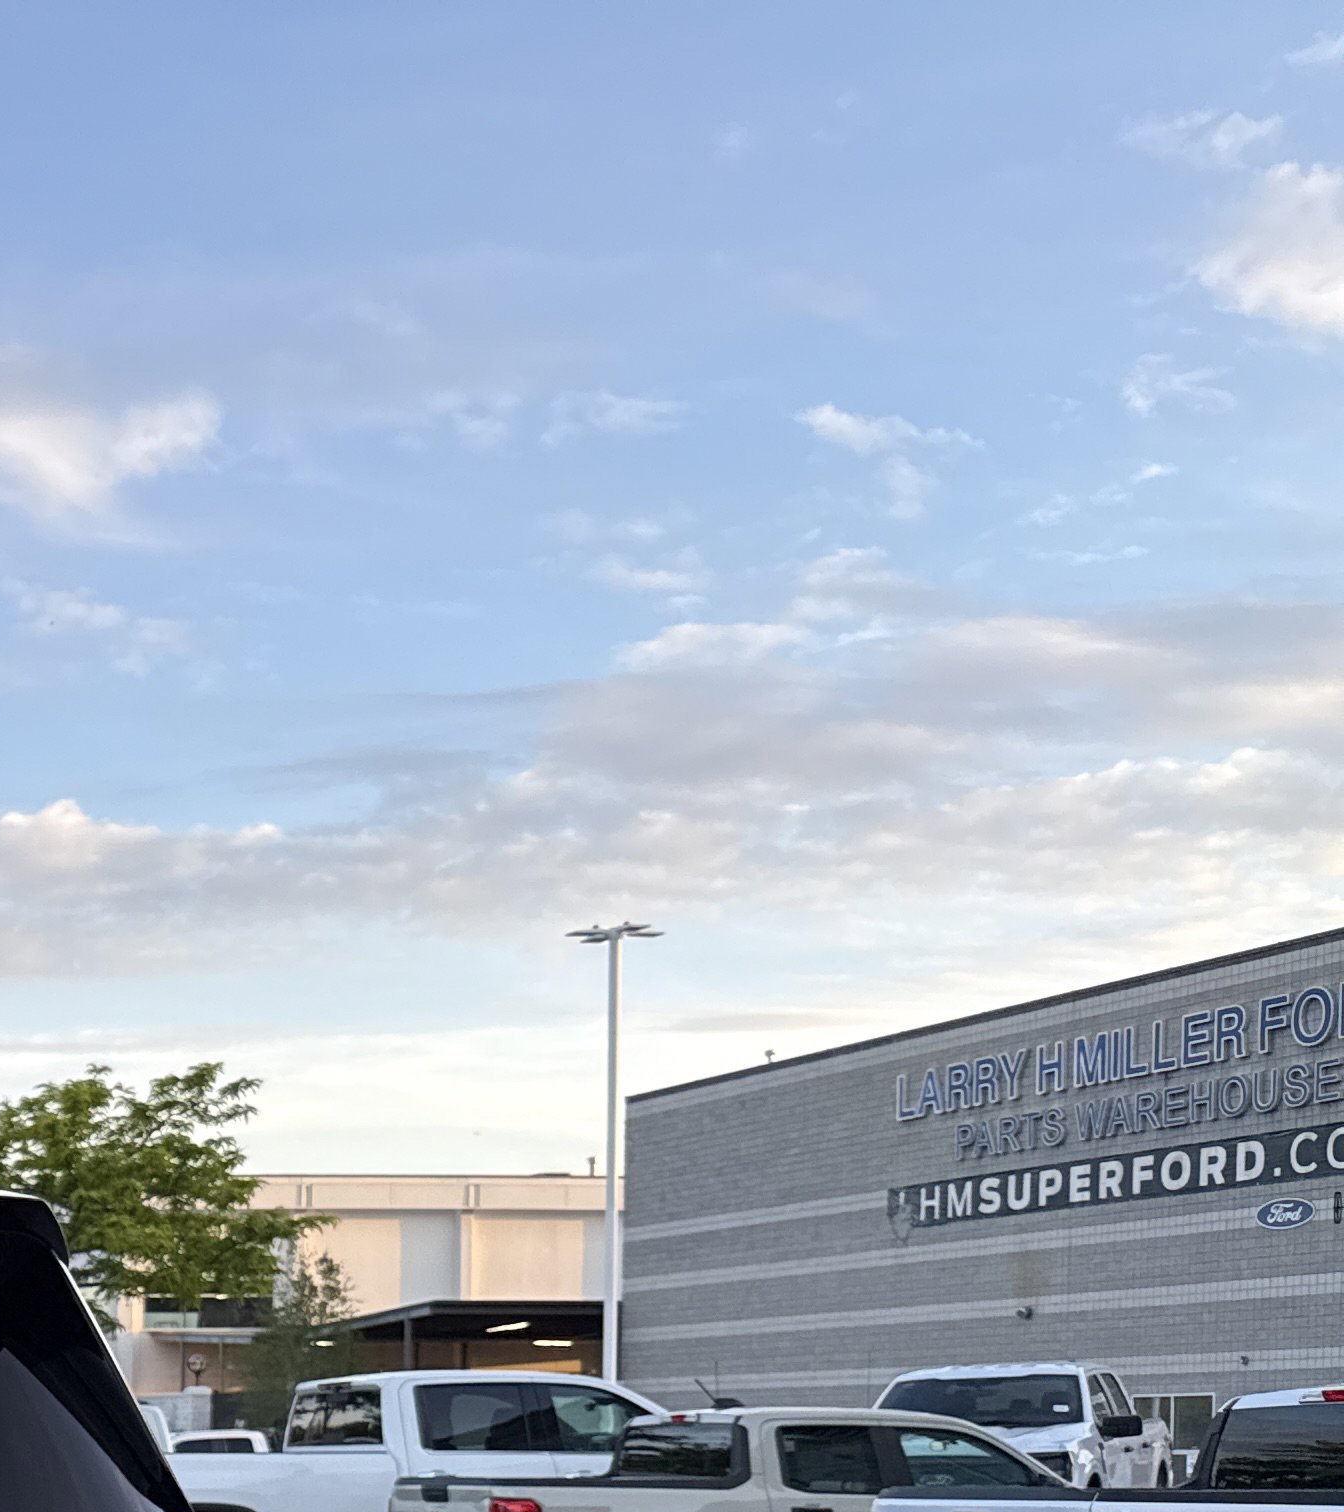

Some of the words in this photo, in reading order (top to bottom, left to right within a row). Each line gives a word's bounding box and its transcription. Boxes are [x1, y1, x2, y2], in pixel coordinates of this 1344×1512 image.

[896, 1048, 1026, 1121] LARRY
[1036, 1041, 1065, 1095] H
[1074, 1004, 1246, 1087] MILLER
[1259, 981, 1344, 1054] FO
[954, 1107, 1064, 1160] PARTS
[1074, 1059, 1341, 1140] WAREHOUSE
[1267, 1203, 1303, 1223] Ford
